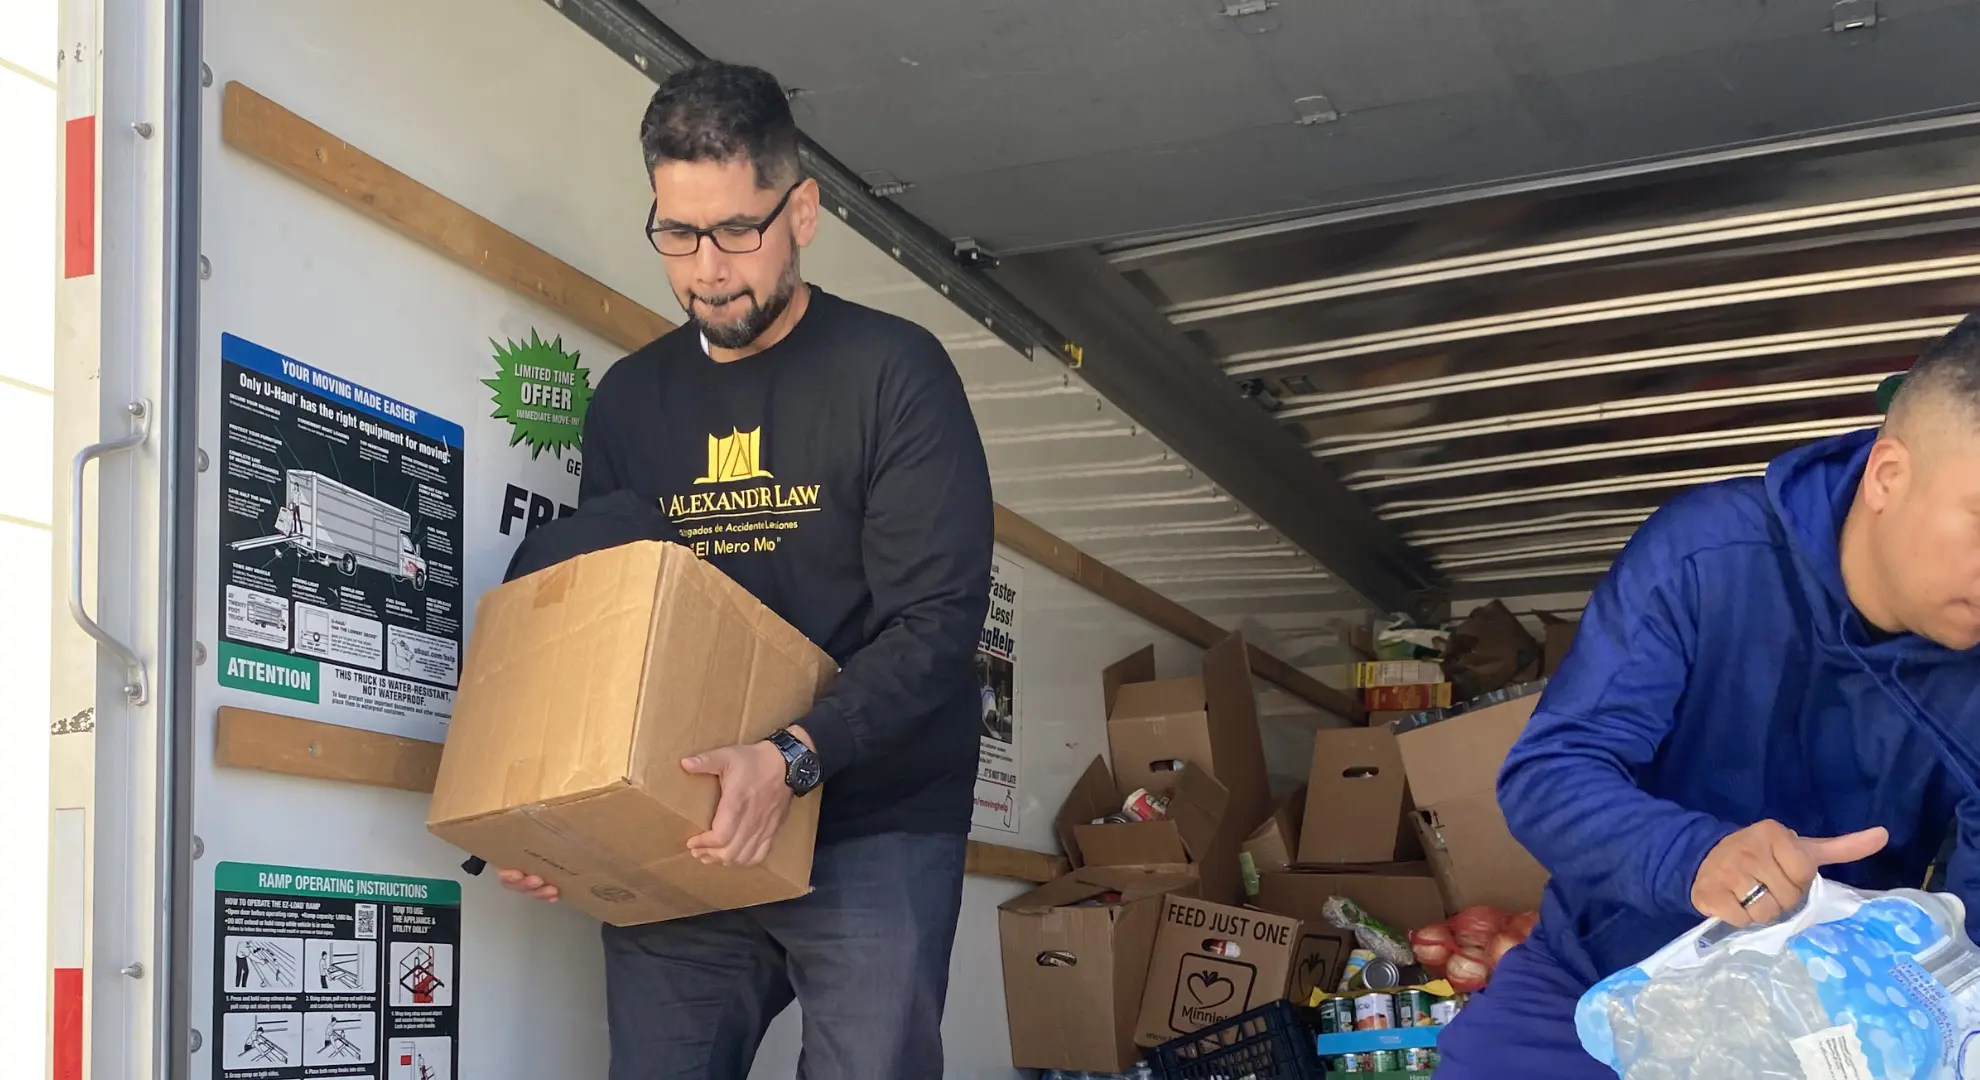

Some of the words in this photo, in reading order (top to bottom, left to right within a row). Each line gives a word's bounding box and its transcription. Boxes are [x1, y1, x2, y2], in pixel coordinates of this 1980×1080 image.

[514, 363, 551, 381] LIMITED
[553, 370, 575, 385] TIME
[282, 359, 310, 383] YOUR
[312, 371, 352, 400] MOVING
[354, 388, 382, 411] MADE
[383, 400, 416, 424] EASIER
[521, 381, 572, 410] OFFER
[240, 373, 261, 395] Only
[300, 395, 317, 413] has
[320, 402, 334, 419] the
[336, 410, 357, 428] right
[359, 420, 404, 445] equipment
[405, 435, 417, 450] for
[517, 409, 551, 422] IMMEDIATE
[774, 484, 821, 506] LAW
[714, 539, 750, 554] Mero
[990, 600, 1013, 626] Less!
[227, 656, 311, 690] ATTENTION
[335, 669, 351, 681] THIS
[354, 672, 377, 686] TRUCK
[379, 678, 386, 688] IS
[388, 679, 451, 702] WATER-RESISTANT,
[362, 685, 376, 697] NOT
[378, 688, 426, 706] WATERPROOF.
[259, 872, 292, 889] RAMP
[295, 875, 353, 893] OPERATING
[355, 880, 427, 898] INSTRUCTIONS
[239, 898, 246, 906] TO
[247, 899, 270, 907] OPERATE
[272, 900, 281, 908] THE
[306, 902, 320, 910] RAMP
[392, 905, 405, 914] HOW
[406, 906, 412, 914] TO
[414, 907, 423, 915] USE
[392, 915, 402, 923] THE
[403, 915, 431, 924] APPLIANCE
[392, 924, 411, 932] UTILITY
[1168, 903, 1206, 928] FEED
[1209, 912, 1250, 937] JUST
[1253, 921, 1289, 945] ONE
